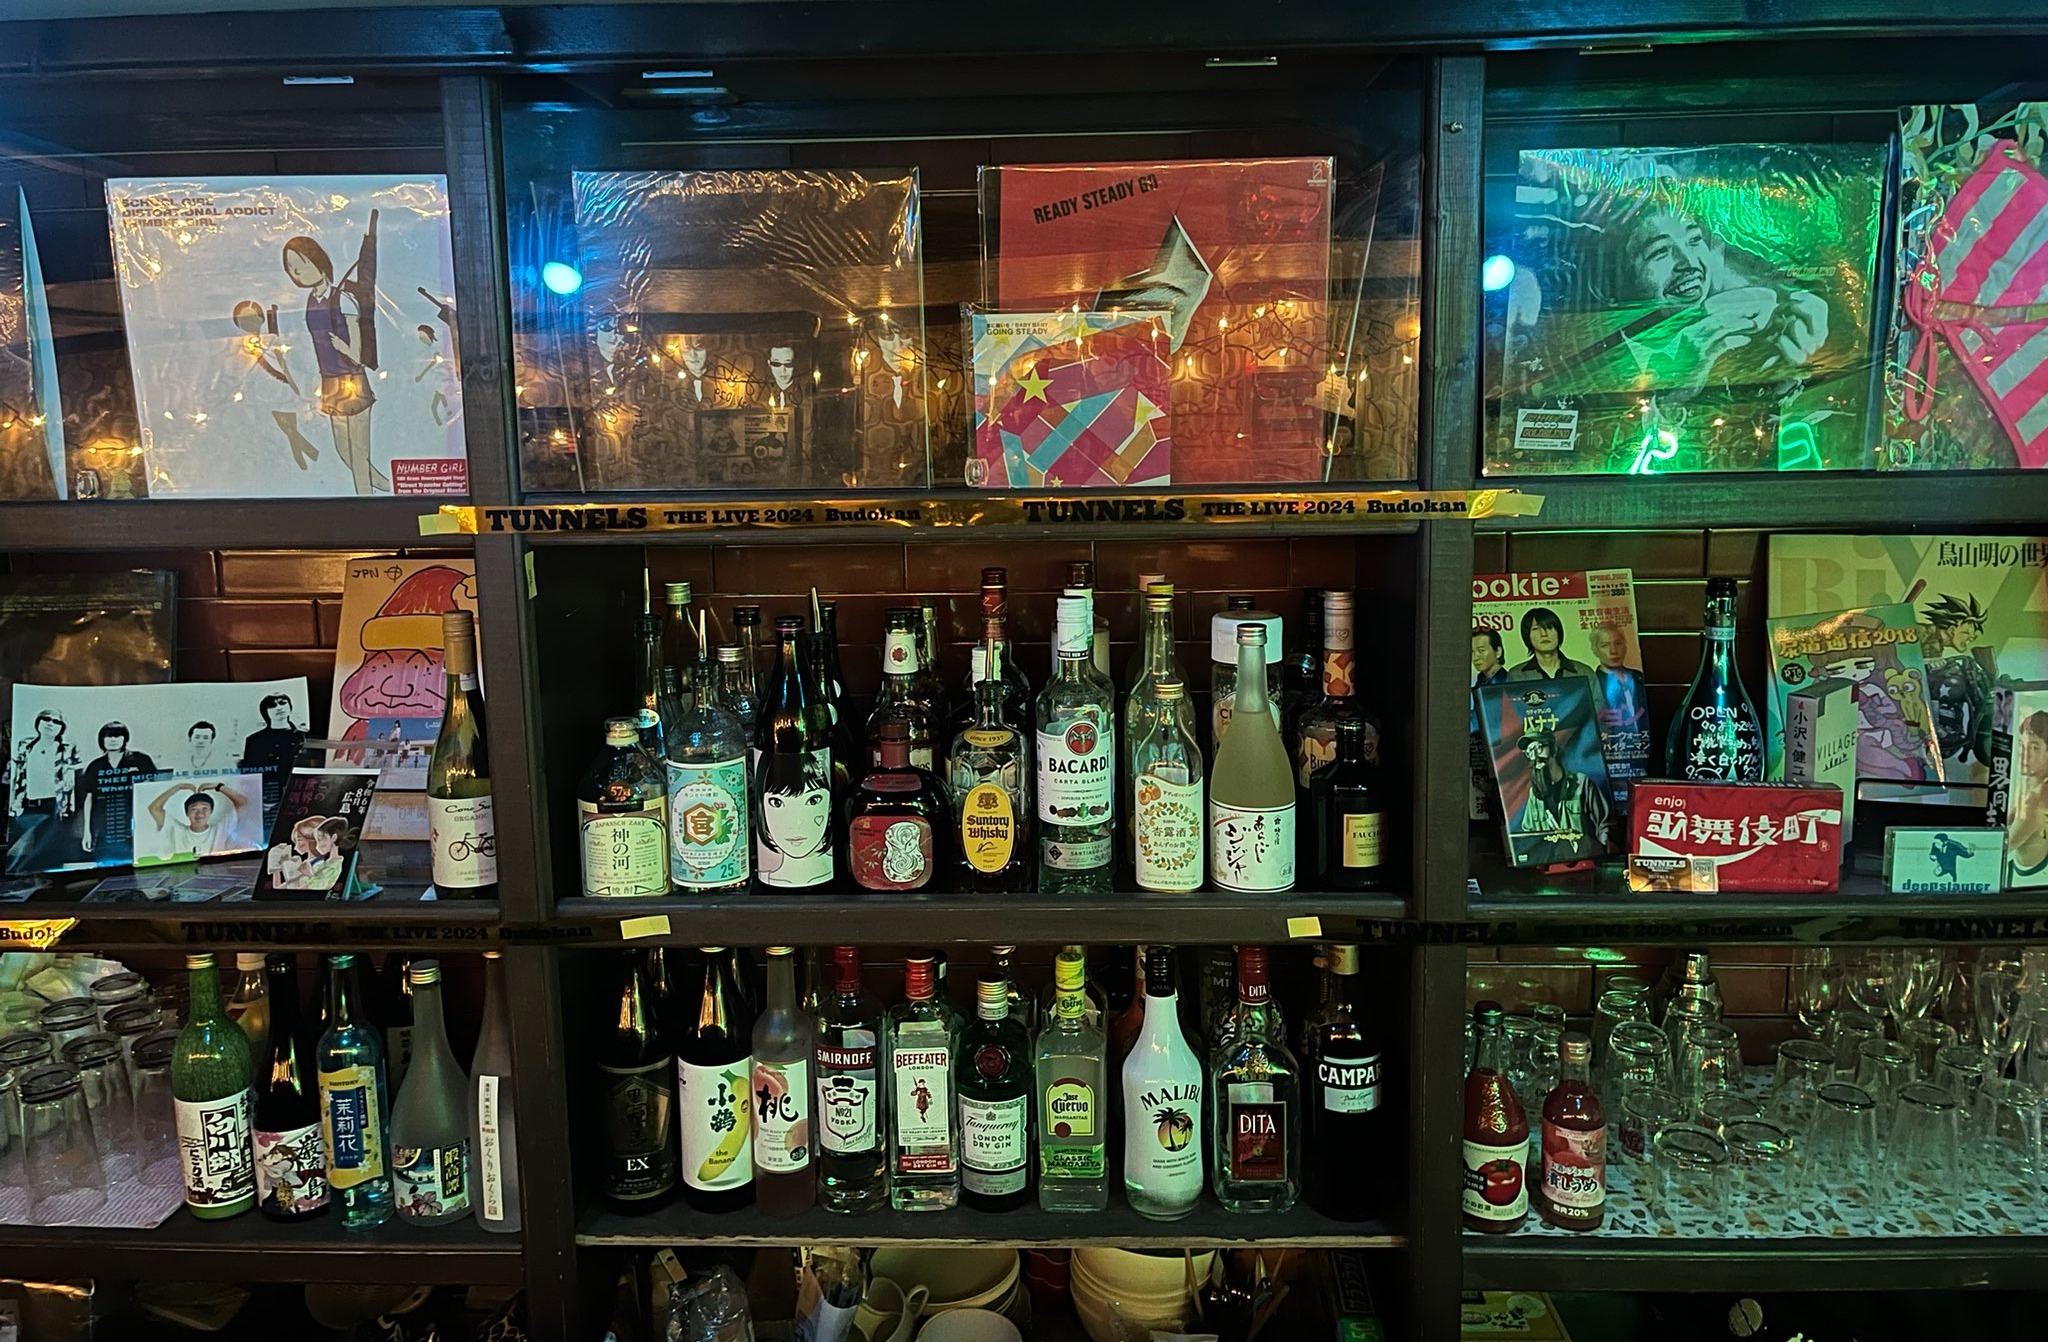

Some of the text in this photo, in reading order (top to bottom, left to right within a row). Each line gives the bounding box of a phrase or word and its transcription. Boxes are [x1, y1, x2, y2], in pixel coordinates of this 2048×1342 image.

[1033, 197, 1078, 224] READY
[1082, 179, 1134, 210] STEADY
[222, 207, 276, 216] ADDICT
[1016, 327, 1049, 335] STEADY
[396, 463, 465, 474] NUMBER GIRL
[1023, 499, 1468, 523] TUNNELS THE LIVE 2024 Budokan
[485, 507, 921, 532] TUNNELS THE LIVE 2024 Budokan
[352, 567, 379, 579] JPN
[1472, 573, 1560, 599] ookie
[1472, 615, 1514, 632] OSSO
[1691, 706, 1738, 721] OPEN
[1523, 714, 1560, 733] バナナ
[1817, 725, 1857, 756] VILLAGE
[1048, 750, 1110, 774] BACARDÍ
[98, 776, 128, 785] THEE
[193, 769, 218, 777] GUN
[222, 765, 279, 775] ELEPHANT
[1082, 775, 1107, 784] BLANCA
[339, 791, 355, 814] 広島
[454, 813, 489, 822] ORGANIC
[966, 814, 1009, 828] Suntory
[967, 827, 1008, 842] Whisky
[1151, 827, 1187, 838] 杏露酒
[1646, 809, 1841, 846] 歌舞伎町
[611, 828, 630, 871] 神の河
[1226, 822, 1252, 883] ジンジャー
[720, 863, 735, 879] 25
[1634, 858, 1686, 868] TUNNELS
[181, 921, 332, 943] TUNNELS
[393, 926, 438, 940] LIVE
[441, 926, 489, 941] 2024
[1356, 919, 1518, 944] TUNNELS
[1249, 986, 1267, 998] DITA
[896, 1052, 947, 1068] BEEFEATER
[756, 1084, 799, 1123] 桃
[1063, 1092, 1079, 1101] Jose
[708, 1083, 736, 1133] 小鶴
[1051, 1098, 1090, 1114] Cuervo
[336, 1098, 359, 1152] 茉莉花
[831, 1117, 857, 1125] VODKA
[965, 1114, 1020, 1132] Tanqueray
[1240, 1114, 1276, 1134] DITA
[206, 1113, 242, 1172] 白川郷
[973, 1133, 1011, 1141] LONDON
[973, 1141, 1012, 1149] DRY GIN
[708, 1156, 736, 1165] Banana
[716, 1149, 728, 1157] the
[627, 1157, 650, 1172] EX
